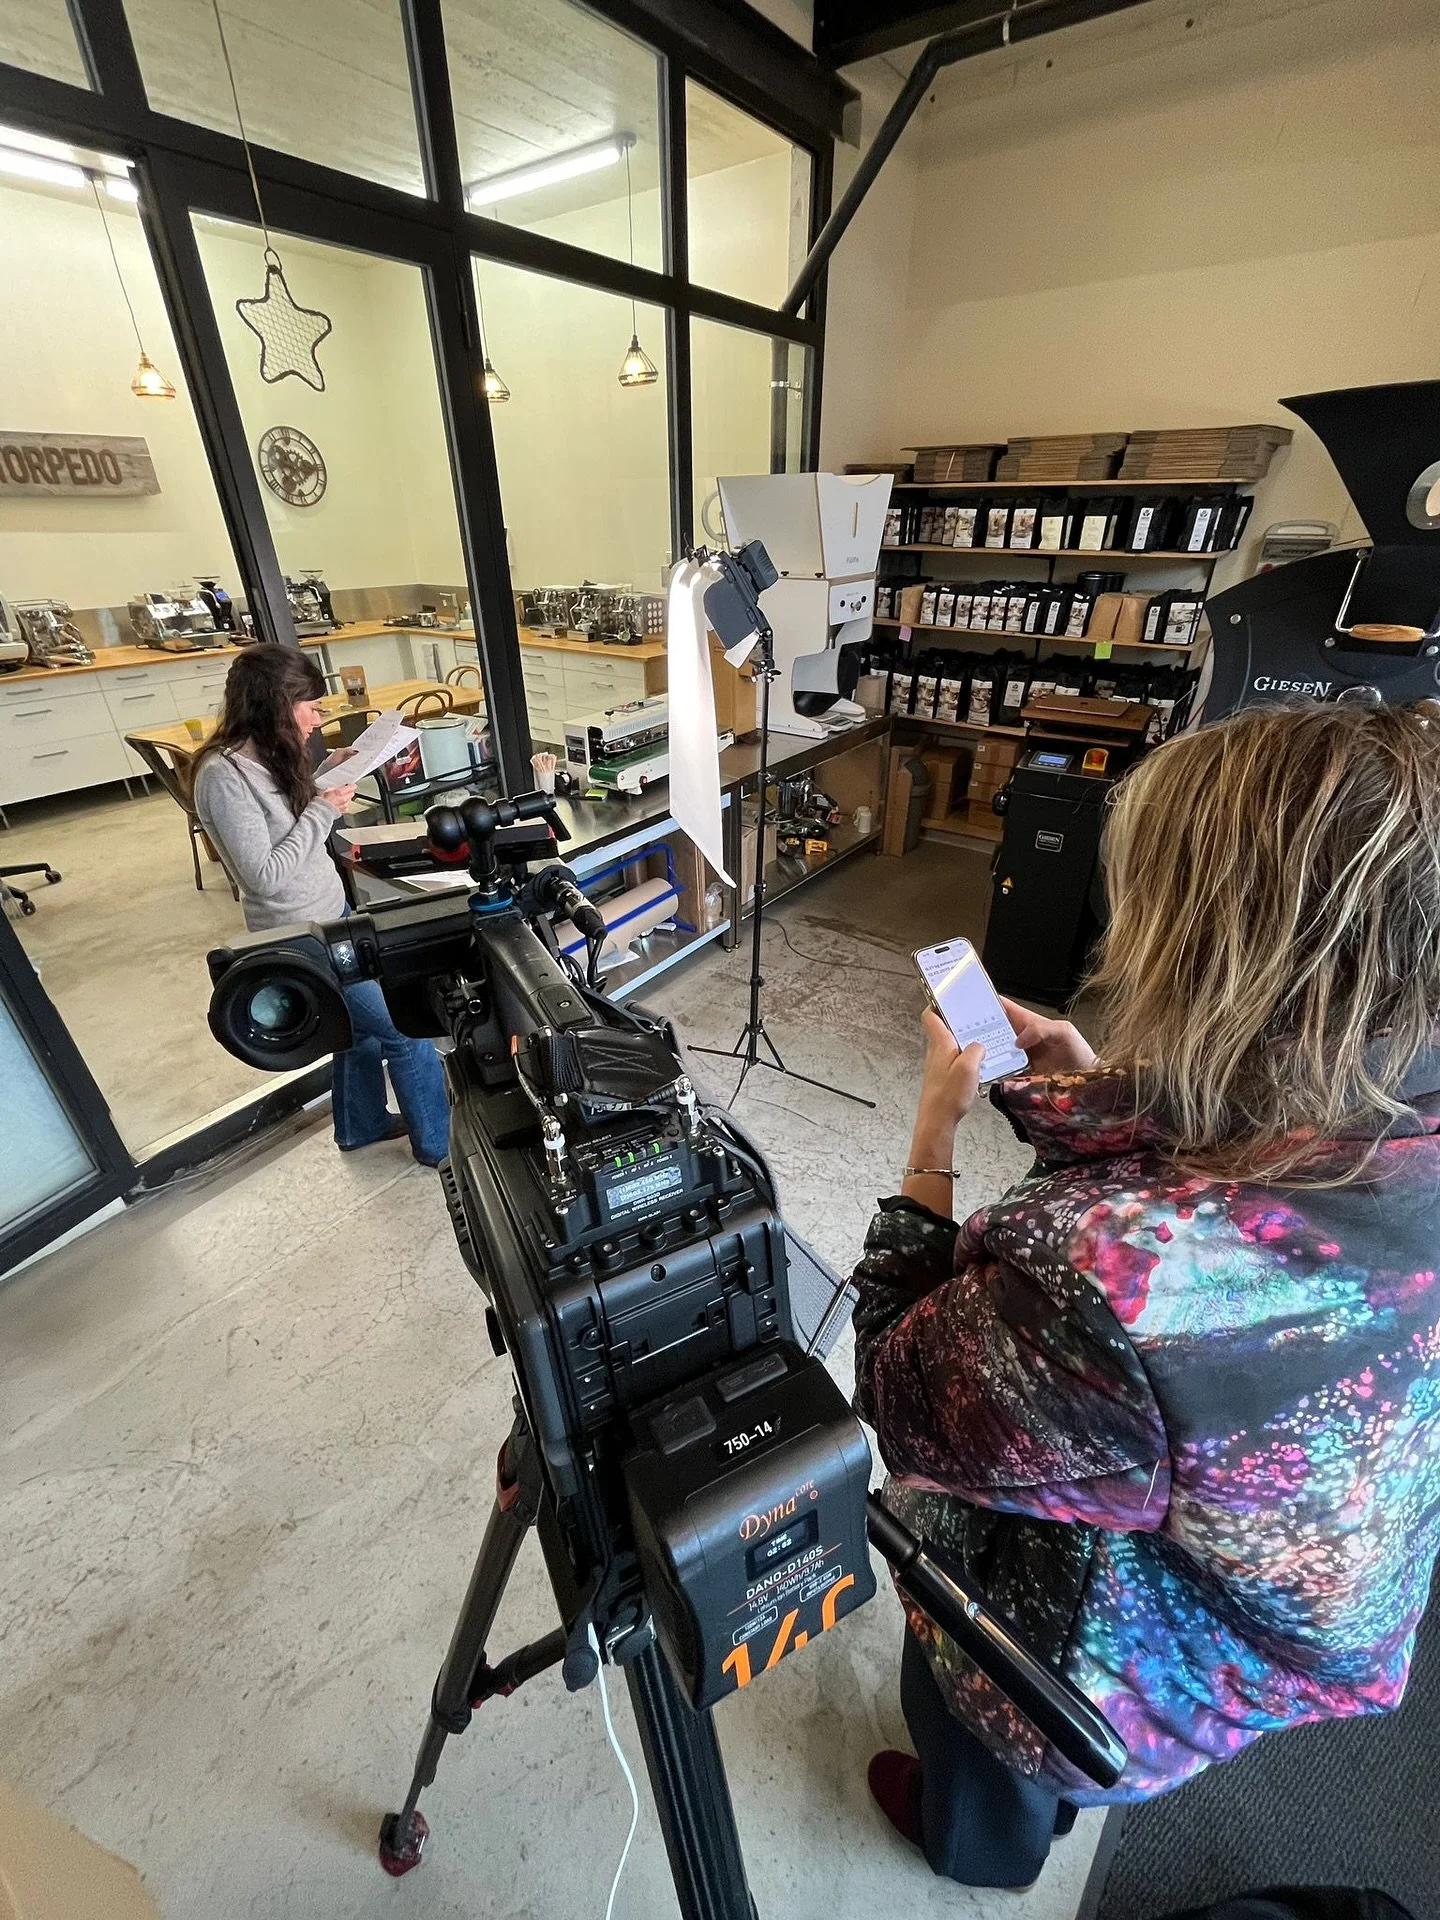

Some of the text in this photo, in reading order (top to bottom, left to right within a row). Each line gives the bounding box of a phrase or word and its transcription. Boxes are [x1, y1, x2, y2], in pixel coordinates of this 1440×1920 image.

[0, 445, 122, 485] ORPEDO
[610, 1188, 684, 1220] DIGITAL WIRELESS RECEIVER
[723, 1420, 773, 1455] 750-14
